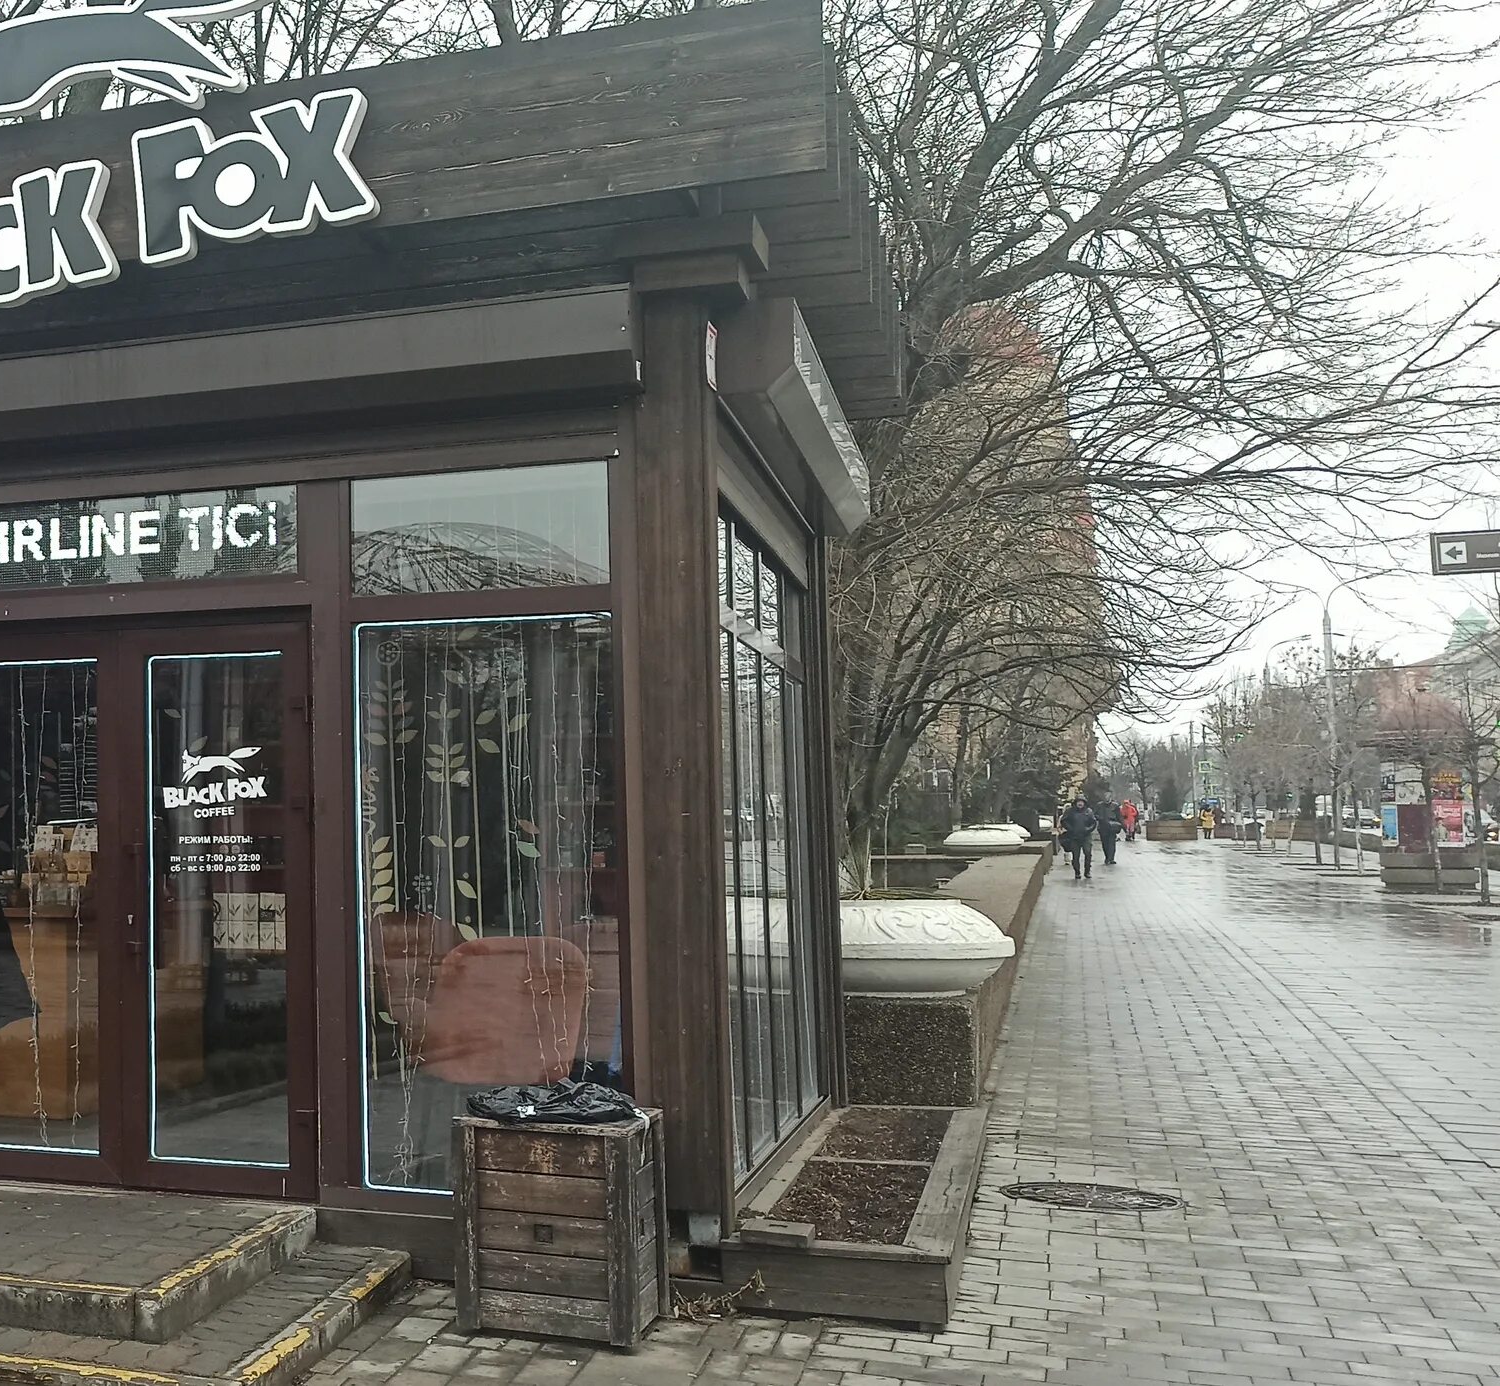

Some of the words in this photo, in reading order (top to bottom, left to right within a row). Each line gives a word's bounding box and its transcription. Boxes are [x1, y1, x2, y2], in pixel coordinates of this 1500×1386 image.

[132, 88, 380, 264] FOX
[162, 782, 226, 809] BLACK
[227, 776, 268, 801] FOX
[193, 806, 235, 819] COFFEE
[178, 835, 211, 845] РЕЖИМ
[212, 835, 253, 845] РАБОТЫ:
[205, 854, 224, 862] 7:00
[225, 855, 236, 863] до
[238, 854, 261, 862] 22:00
[170, 864, 181, 872] сб
[205, 864, 224, 872] 9:00
[225, 865, 236, 873] до
[238, 864, 261, 872] 22:00
